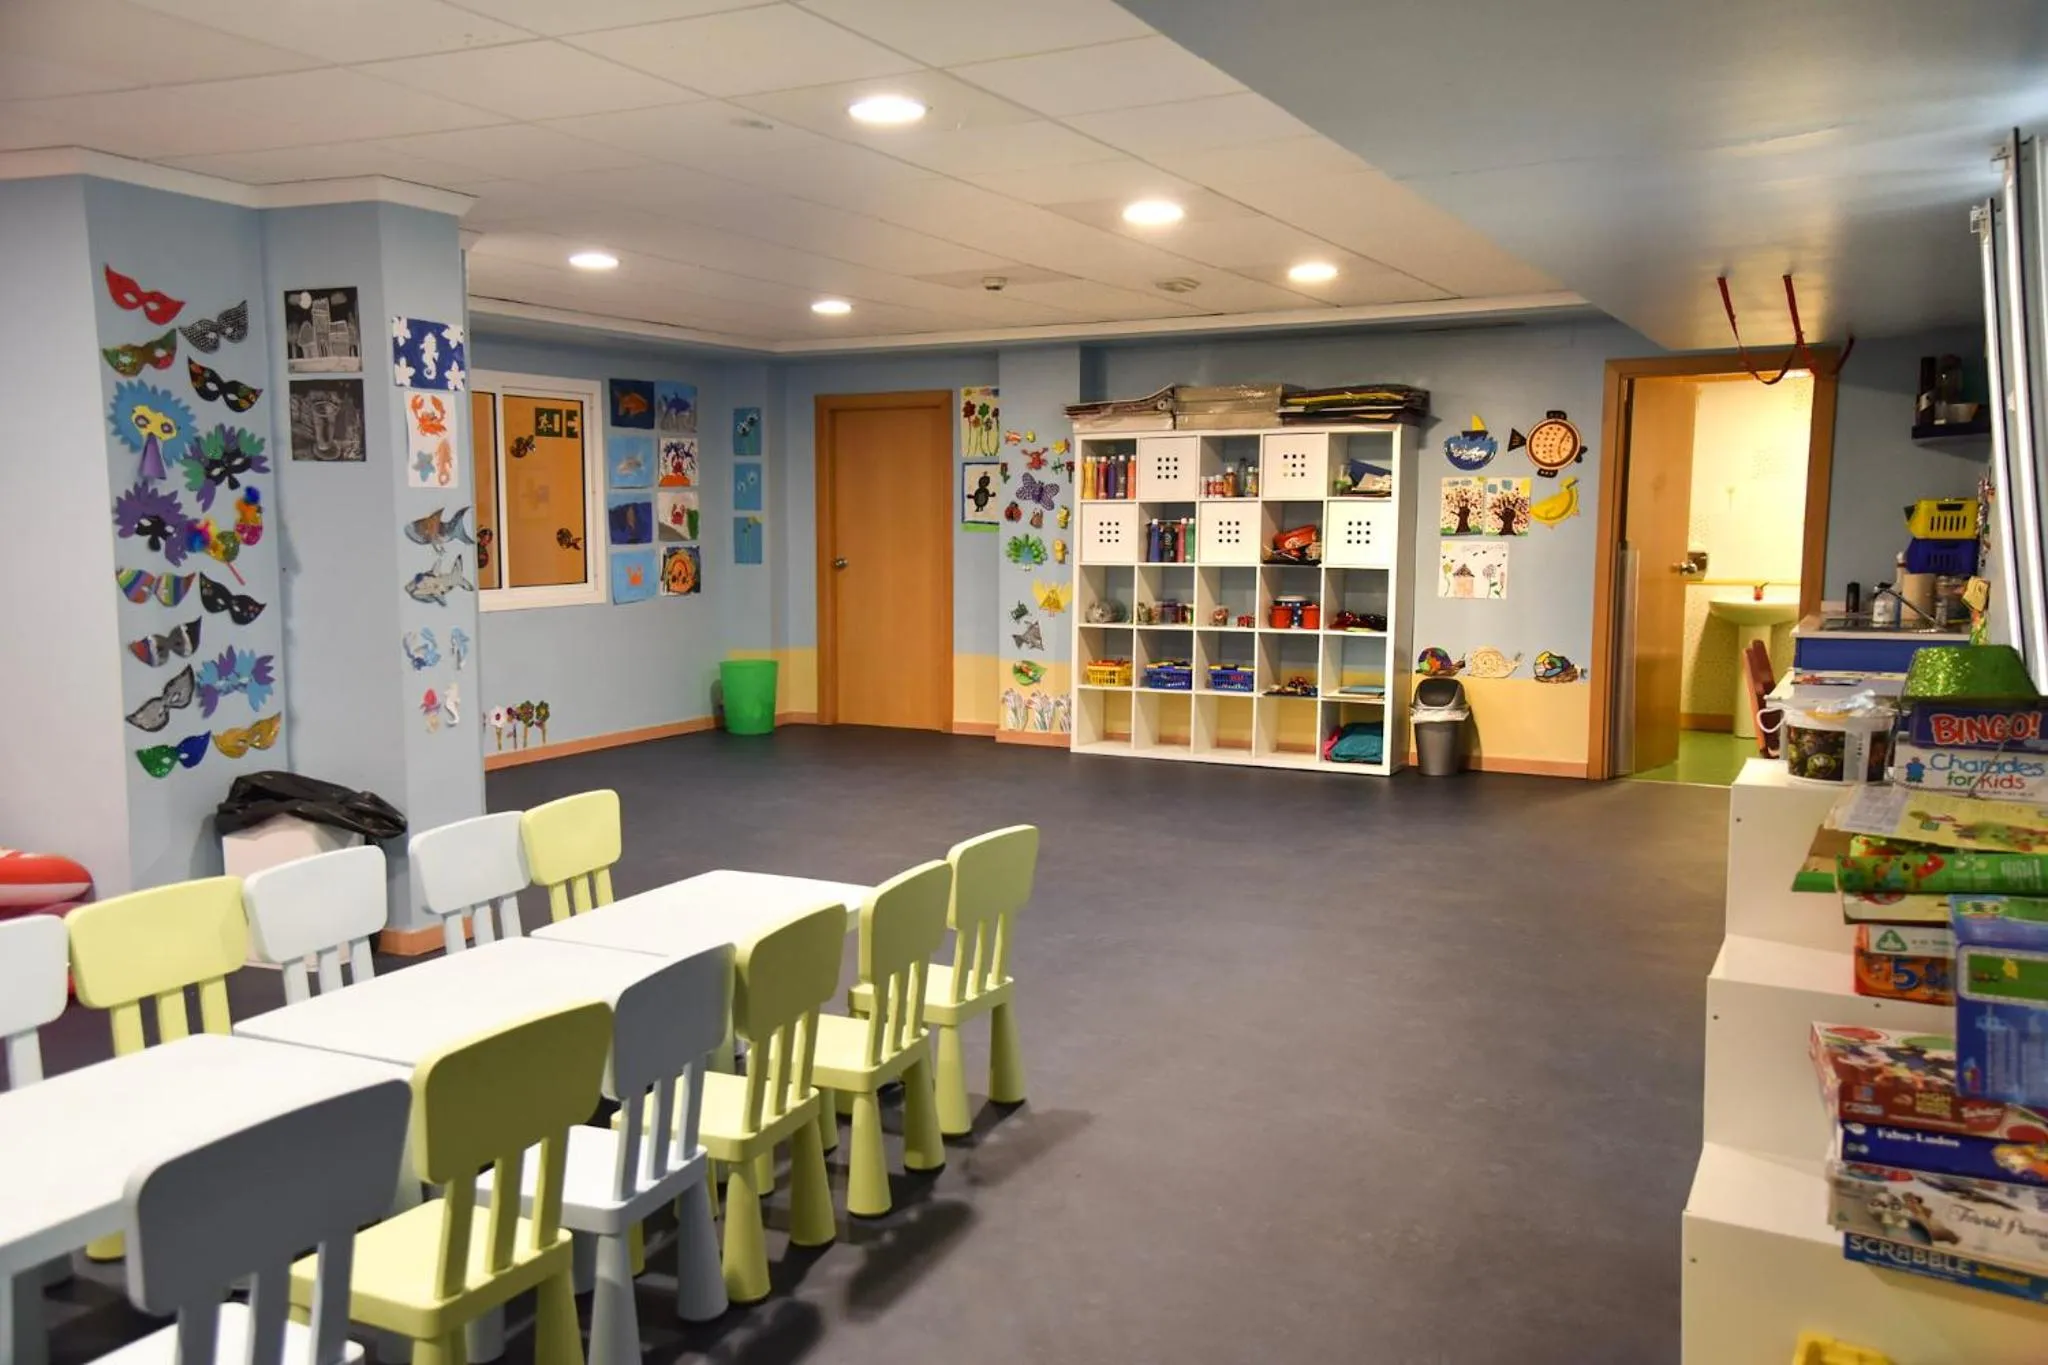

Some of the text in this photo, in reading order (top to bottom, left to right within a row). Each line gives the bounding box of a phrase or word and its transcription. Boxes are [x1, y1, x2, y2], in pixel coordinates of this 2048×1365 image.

[1929, 710, 2042, 745] BINGO!
[1930, 752, 2045, 777] Charades
[1946, 771, 2026, 790] for Kids
[1892, 955, 1919, 991] 5
[1848, 1234, 1972, 1276] SCRABBLE
